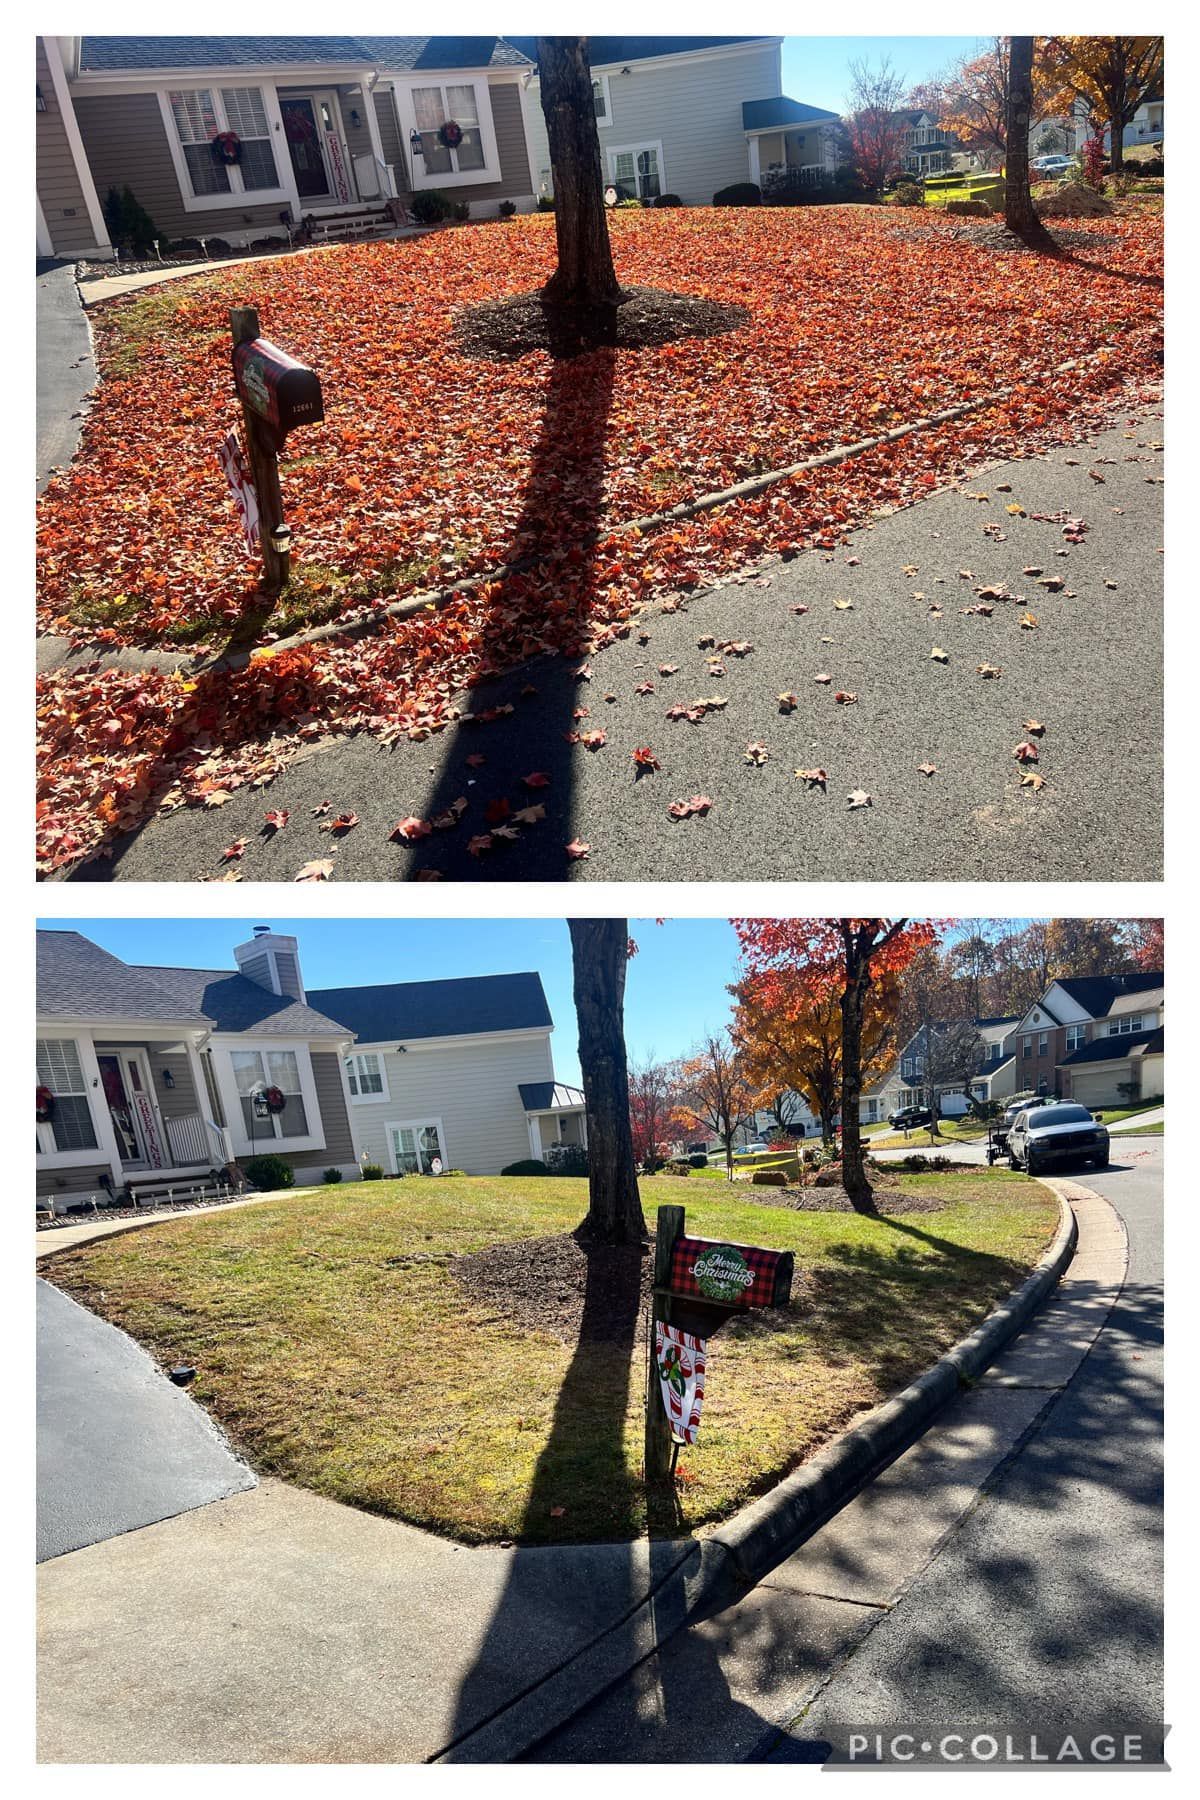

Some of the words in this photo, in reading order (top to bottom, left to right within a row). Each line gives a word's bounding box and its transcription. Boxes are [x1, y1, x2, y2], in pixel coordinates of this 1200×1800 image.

[138, 1098, 162, 1169] GREETINGS
[688, 1260, 756, 1287] Christmas
[707, 1253, 742, 1272] Merry
